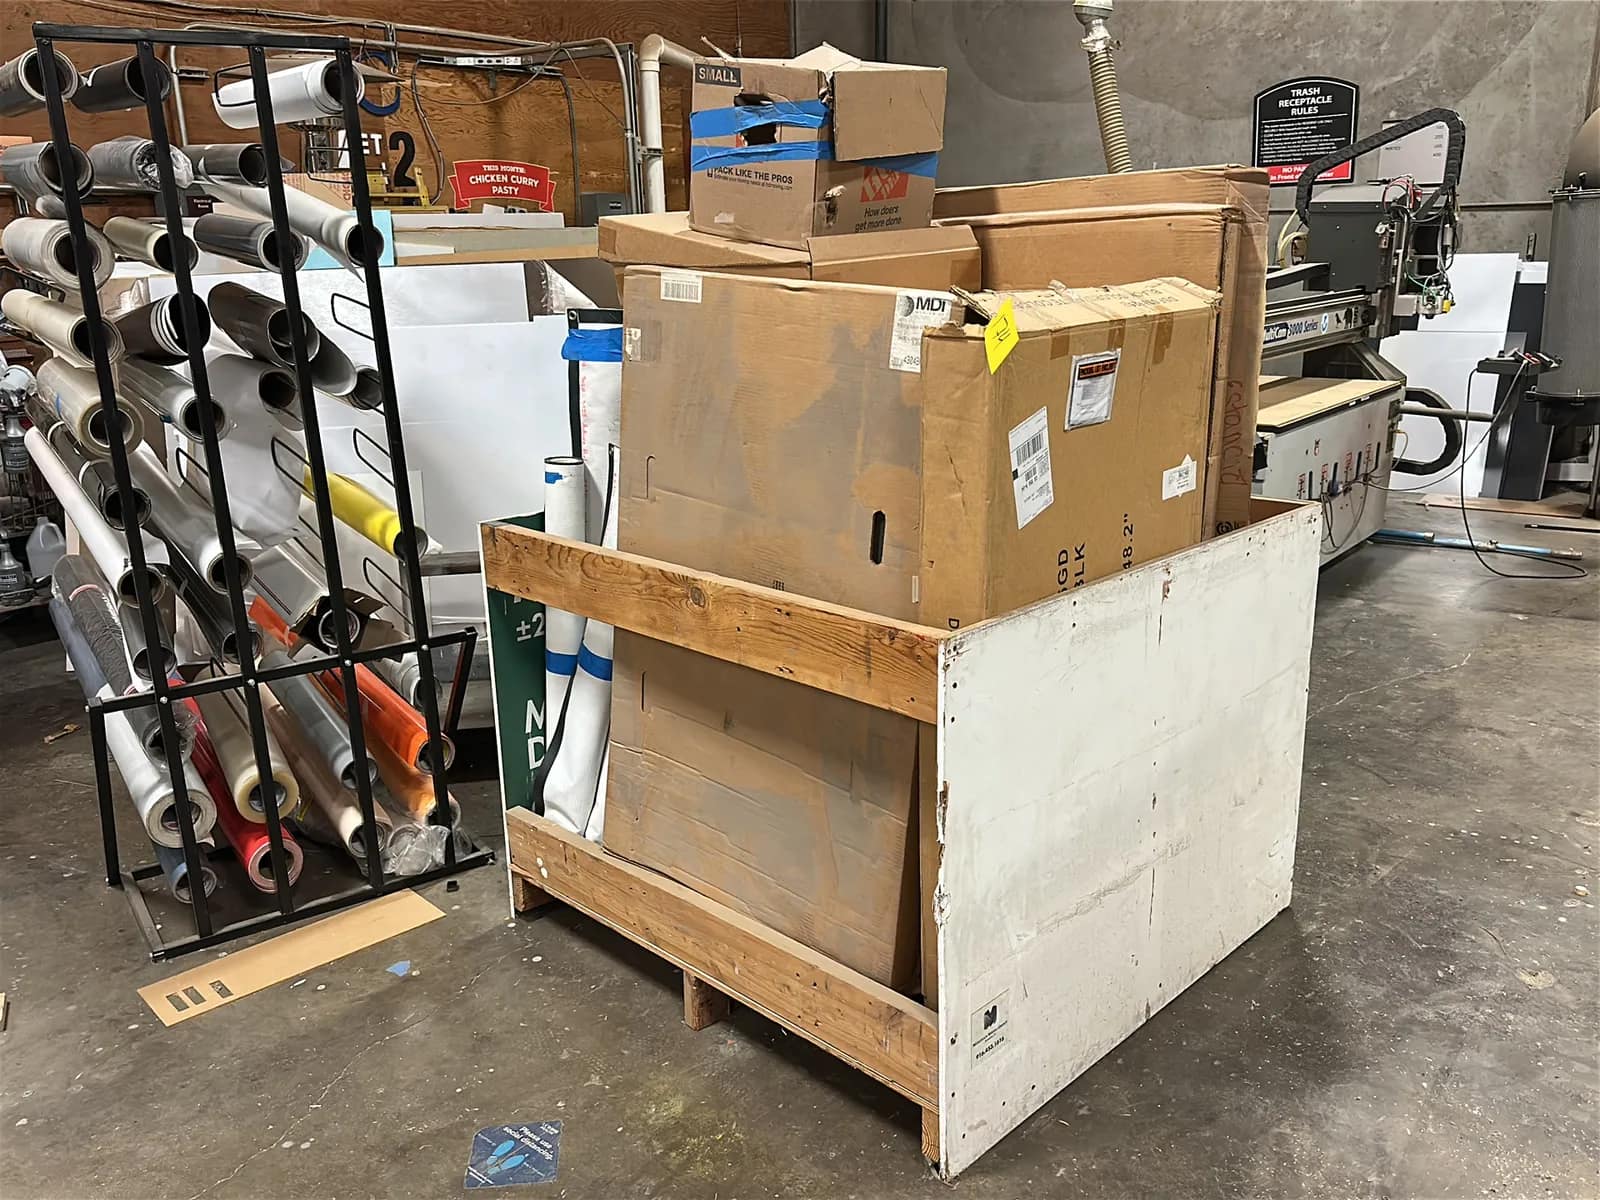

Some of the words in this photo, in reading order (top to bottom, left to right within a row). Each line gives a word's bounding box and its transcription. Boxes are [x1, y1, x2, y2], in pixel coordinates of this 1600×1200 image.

[698, 67, 737, 83] SMALL
[1291, 87, 1320, 97] TRASH
[1279, 96, 1332, 107] RECEPTACLE
[1291, 106, 1318, 115] RULES
[389, 131, 417, 187] 2
[469, 174, 508, 185] CHICKEN
[510, 175, 540, 188] CURRY
[714, 165, 734, 176] PACK
[735, 168, 752, 179] LIKE
[754, 171, 770, 181] THE
[771, 174, 793, 185] PROS
[492, 186, 520, 196] PASTY
[863, 207, 880, 218] How
[880, 205, 899, 216] doers
[854, 221, 867, 233] get
[867, 220, 886, 230] more
[916, 296, 946, 312] MDI
[1057, 549, 1069, 593] GD
[503, 1127, 523, 1139] social
[520, 1127, 540, 1141] Please
